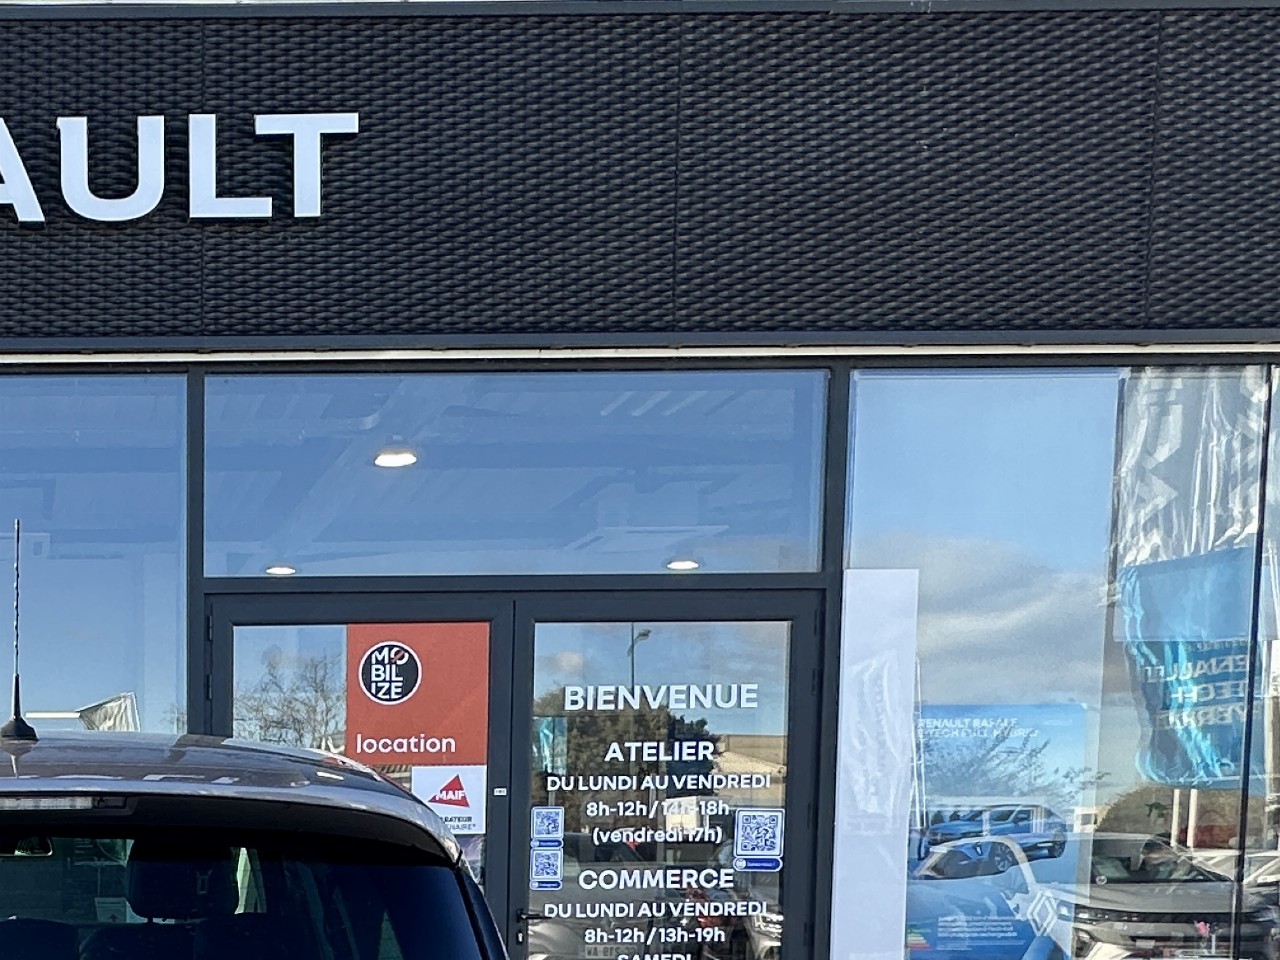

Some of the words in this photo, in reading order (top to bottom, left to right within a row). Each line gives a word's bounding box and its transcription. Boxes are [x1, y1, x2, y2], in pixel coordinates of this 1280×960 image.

[564, 684, 759, 711] BIENVENUE
[356, 733, 456, 754] location
[604, 741, 716, 763] ATELIER
[547, 776, 574, 791] DU
[578, 776, 637, 791] LUNDI
[641, 775, 669, 790] AU
[673, 774, 771, 789] VENDREDI
[435, 789, 465, 801] MAIF
[592, 827, 684, 846] (vendredi
[685, 827, 723, 845] 17h)
[578, 869, 735, 890] COMMERCE
[544, 904, 571, 918] DU
[575, 903, 634, 918] LUNDI
[637, 902, 666, 917] AU
[669, 901, 767, 917] VENDREDI
